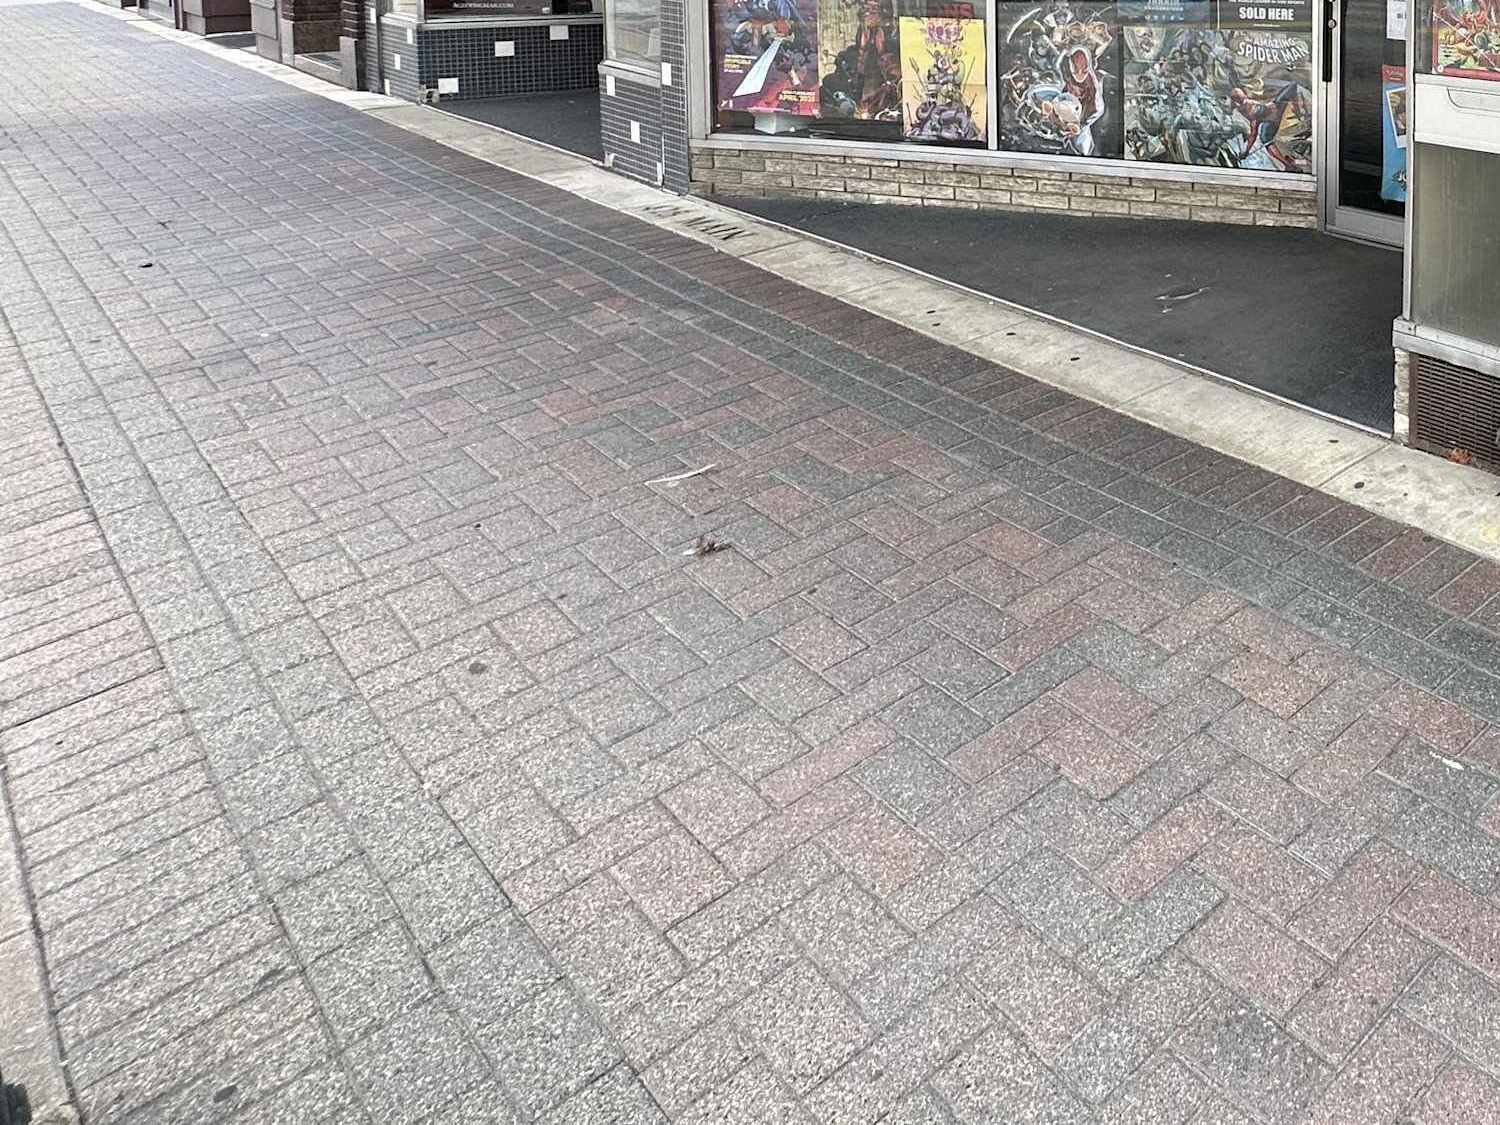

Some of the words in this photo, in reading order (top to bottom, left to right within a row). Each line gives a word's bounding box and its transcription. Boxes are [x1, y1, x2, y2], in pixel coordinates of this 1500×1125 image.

[1239, 7, 1266, 20] SOLD
[1268, 7, 1294, 21] HERE
[1253, 37, 1297, 49] AMAZING
